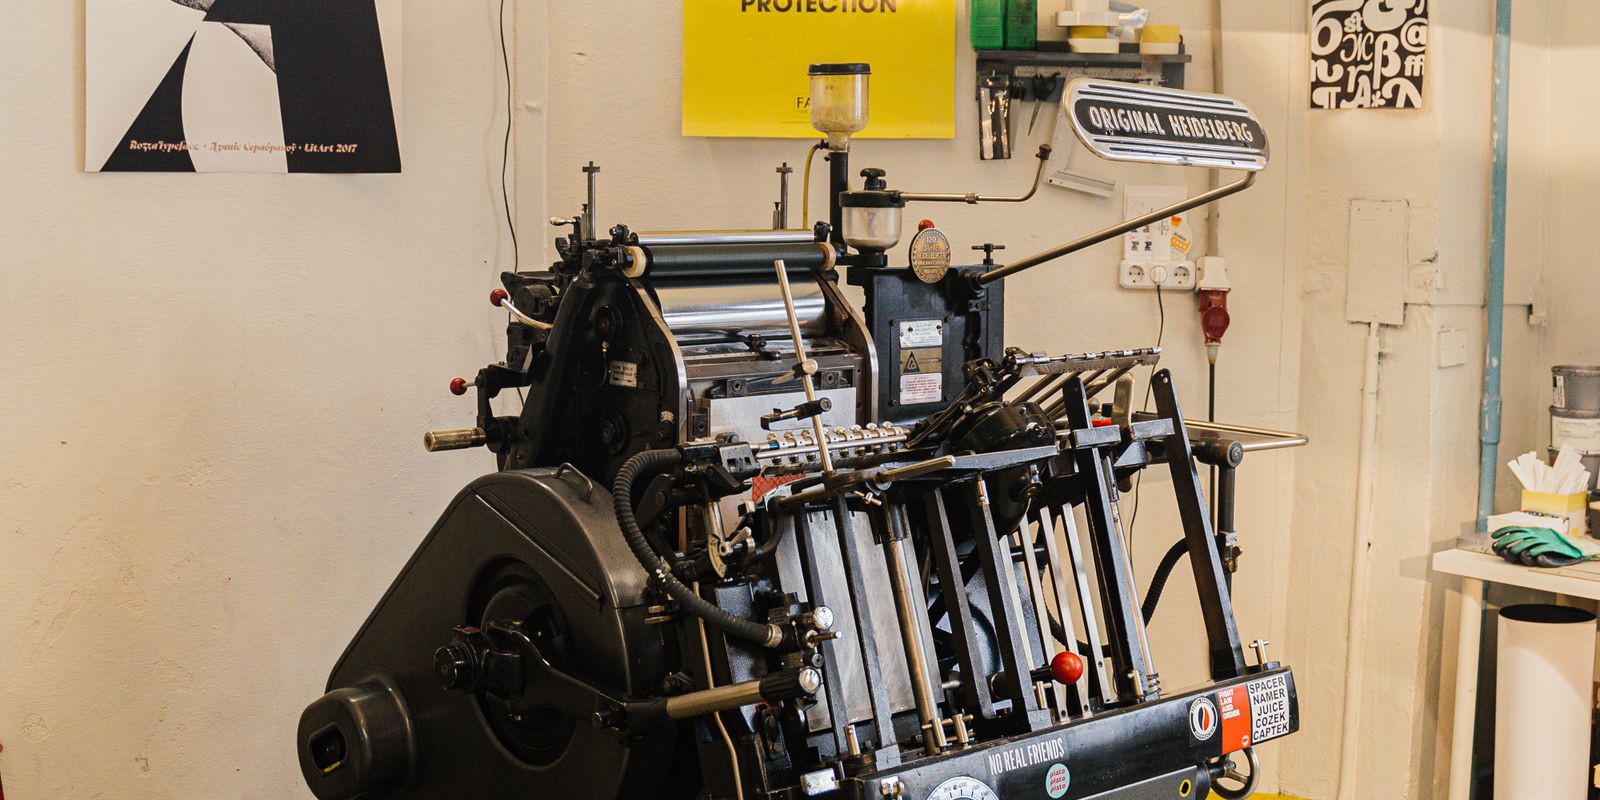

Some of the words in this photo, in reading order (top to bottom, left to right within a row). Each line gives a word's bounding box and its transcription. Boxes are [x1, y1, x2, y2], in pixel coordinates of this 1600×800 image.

[741, 0, 897, 13] PROTECTION
[1089, 106, 1166, 136] ORIGINAL
[1168, 114, 1254, 142] HEIDELBERG
[303, 143, 334, 153] LitArt
[335, 143, 358, 153] 2017
[1249, 676, 1285, 694] SPACER
[1253, 689, 1286, 706] NAMER
[1257, 701, 1284, 716] JUICE
[1255, 711, 1286, 729] COZEK
[1253, 722, 1288, 741] CAPTEK
[988, 753, 1003, 776] NO
[1003, 747, 1028, 772] REAL
[1027, 737, 1065, 765] FRIENDS
